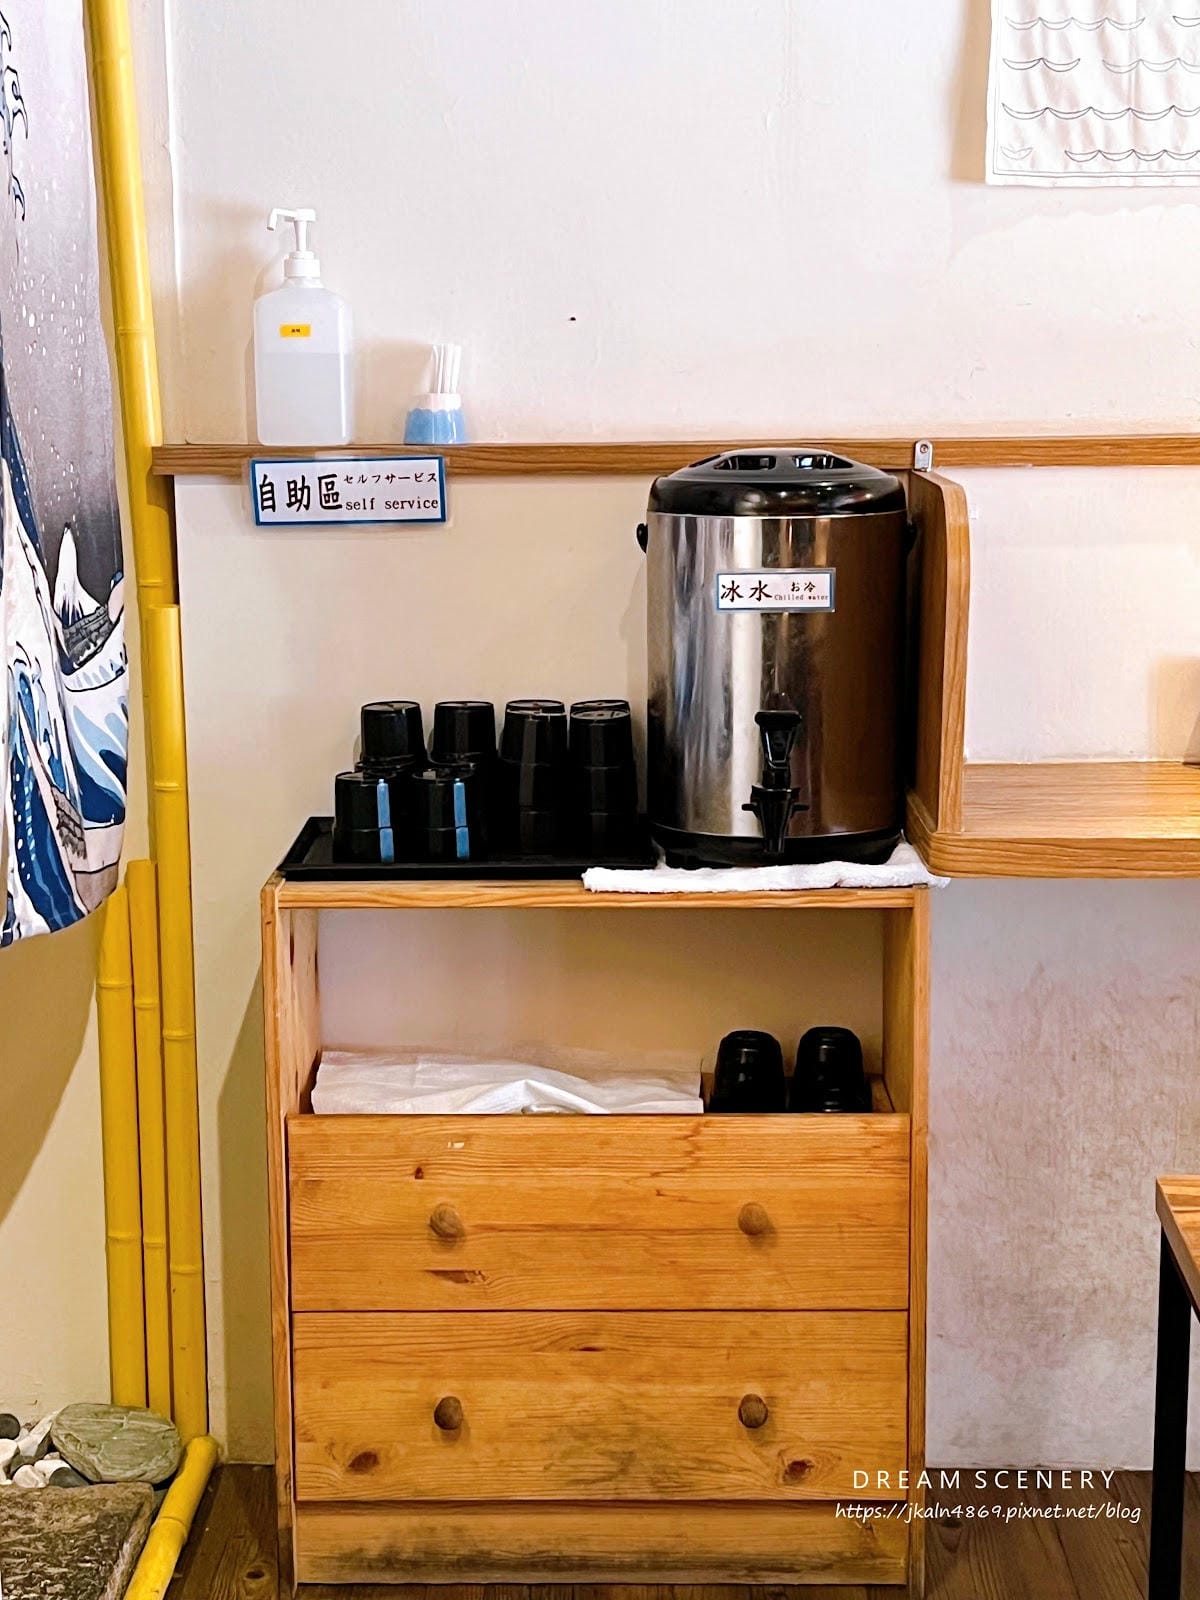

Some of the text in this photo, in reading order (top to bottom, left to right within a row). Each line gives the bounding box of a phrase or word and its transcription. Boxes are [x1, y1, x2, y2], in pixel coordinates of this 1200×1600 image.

[344, 472, 437, 485] セルフサービス
[259, 474, 342, 512] 自助區
[345, 496, 439, 511] self service
[720, 580, 772, 602] 冰水
[791, 581, 816, 592] お冷
